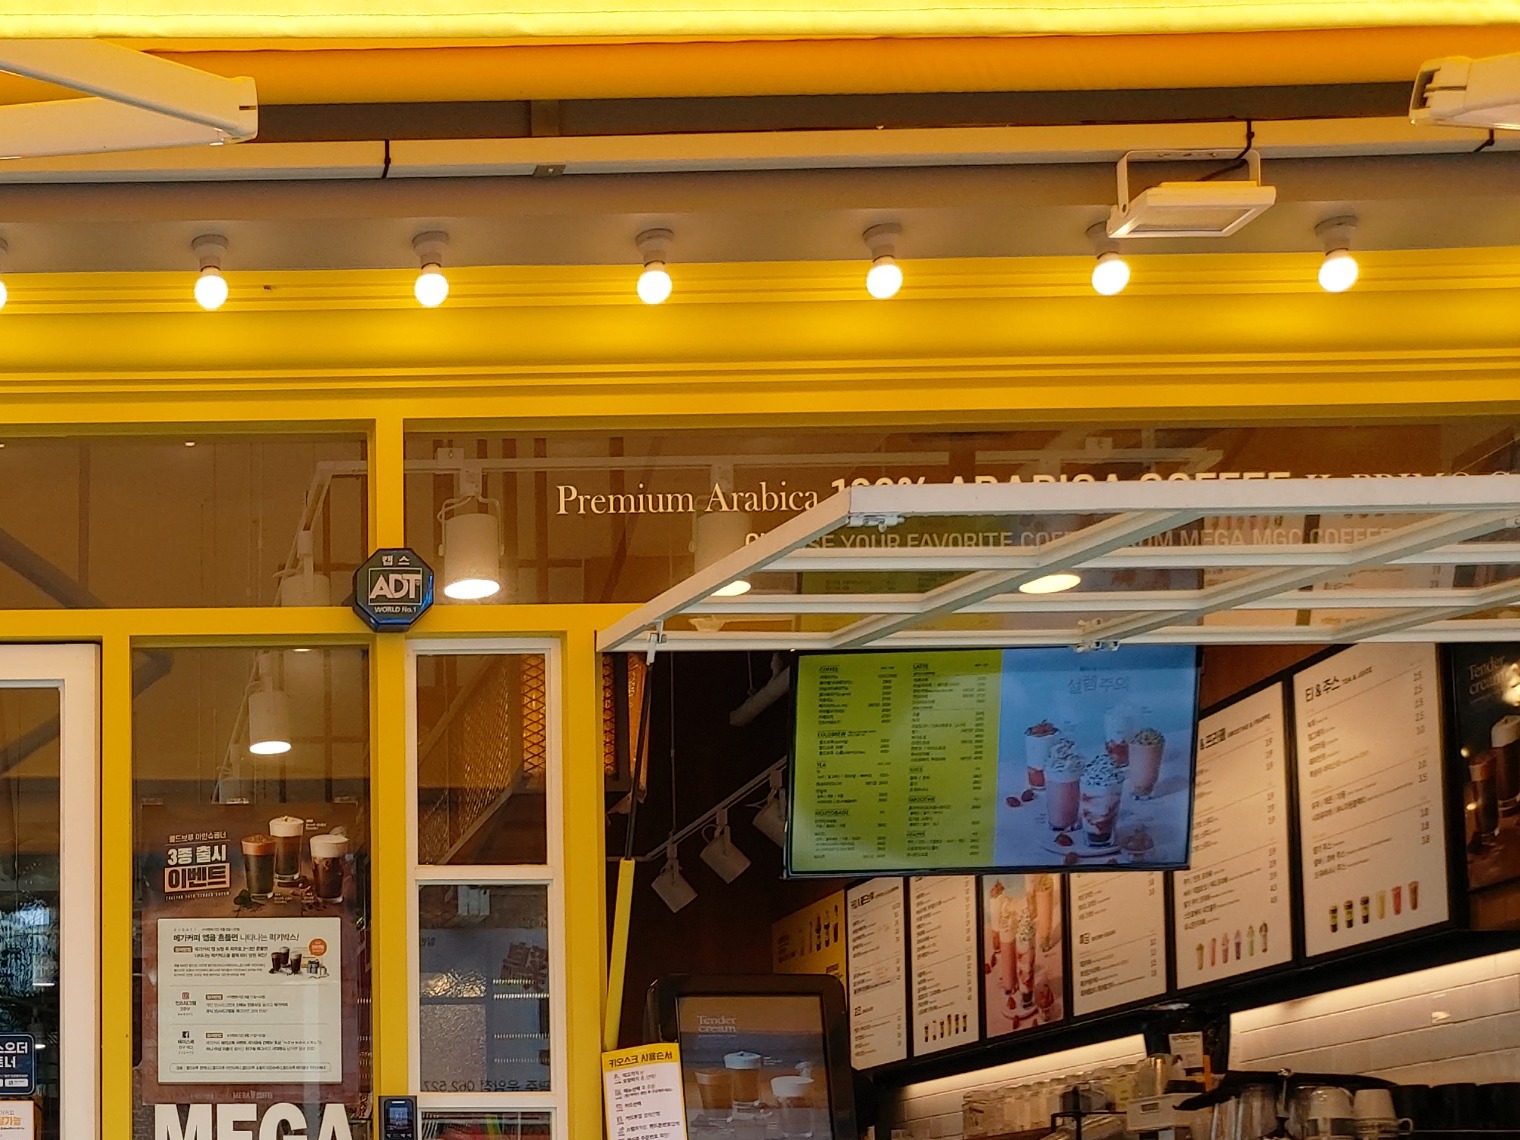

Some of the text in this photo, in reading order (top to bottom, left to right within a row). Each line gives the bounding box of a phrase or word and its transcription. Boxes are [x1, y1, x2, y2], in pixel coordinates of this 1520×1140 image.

[556, 483, 693, 515] Premium
[705, 482, 819, 513] Arabica
[369, 573, 422, 599] ADT
[167, 844, 227, 866] 3종 출시
[168, 865, 227, 889] 이벤트
[697, 1015, 736, 1024] Tender
[698, 1024, 736, 1033] cream
[609, 1056, 639, 1068] 키오스크
